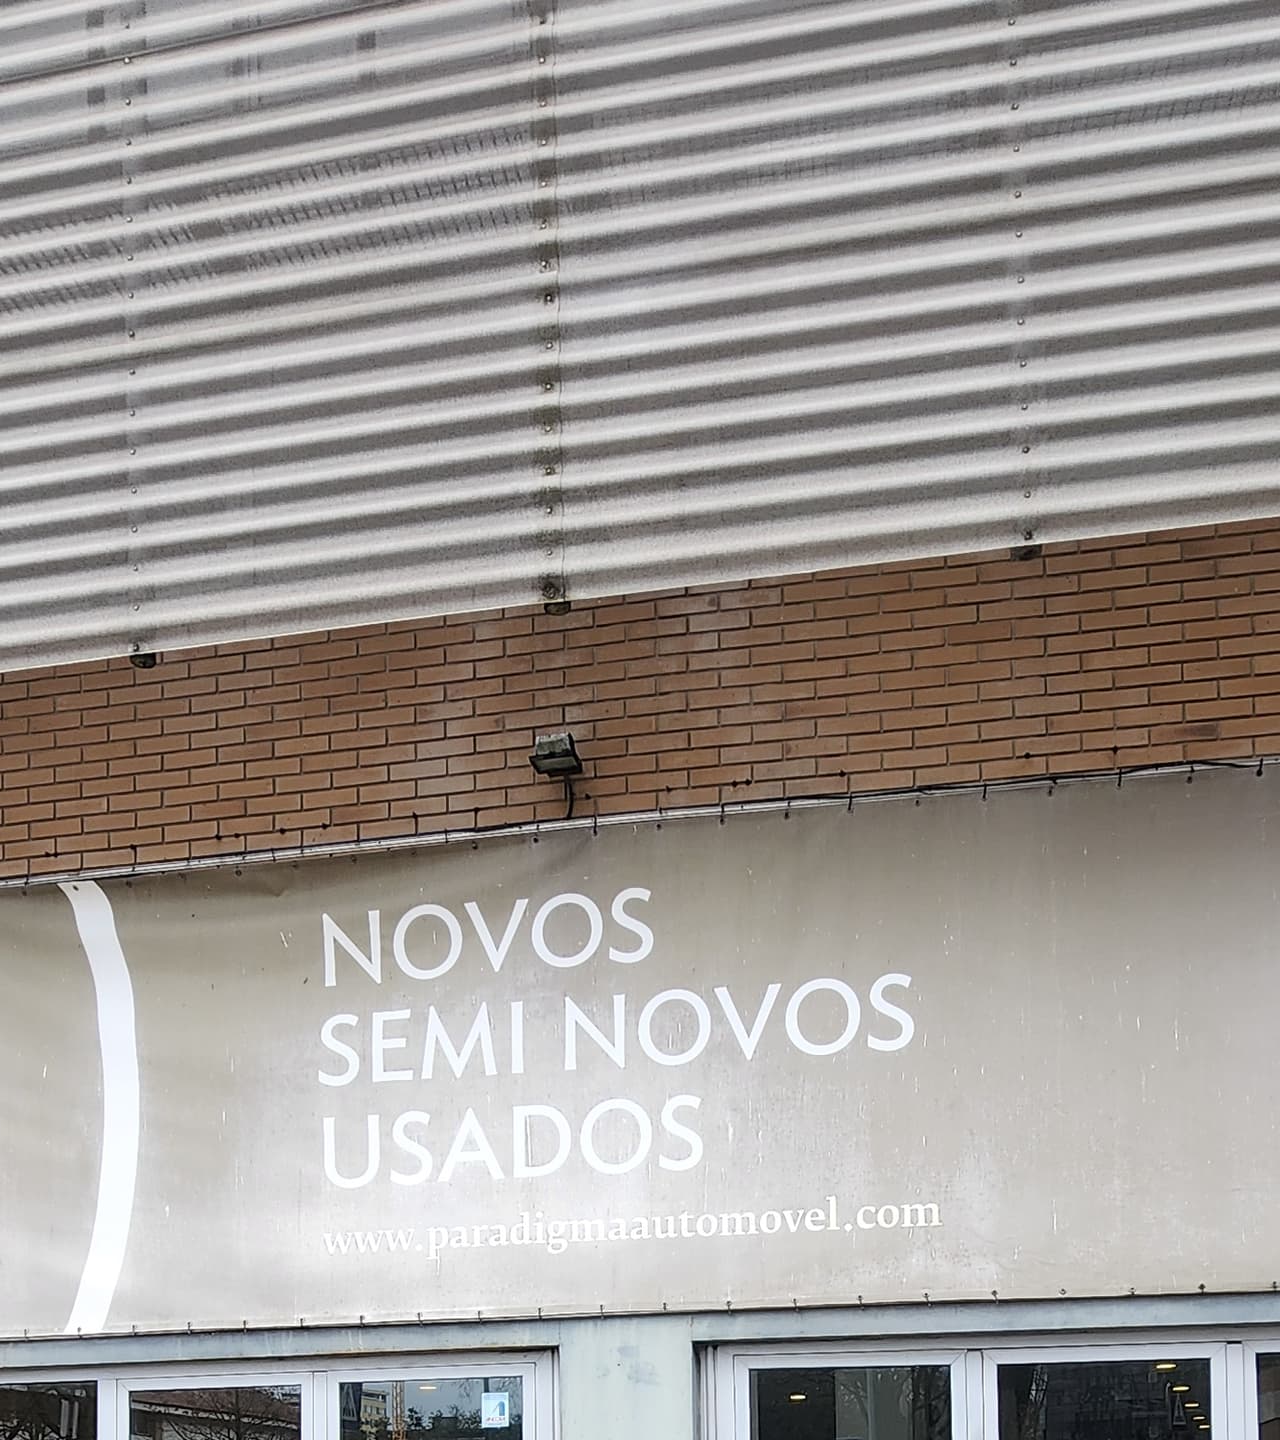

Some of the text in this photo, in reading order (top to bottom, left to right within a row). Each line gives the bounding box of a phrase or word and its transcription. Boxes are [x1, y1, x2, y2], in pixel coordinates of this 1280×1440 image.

[322, 886, 655, 987] NOVOS
[318, 973, 916, 1087] SEMI NOVOS
[322, 1095, 704, 1189] USADOS
[322, 1196, 943, 1258] www.paradigmaautomovel.com
